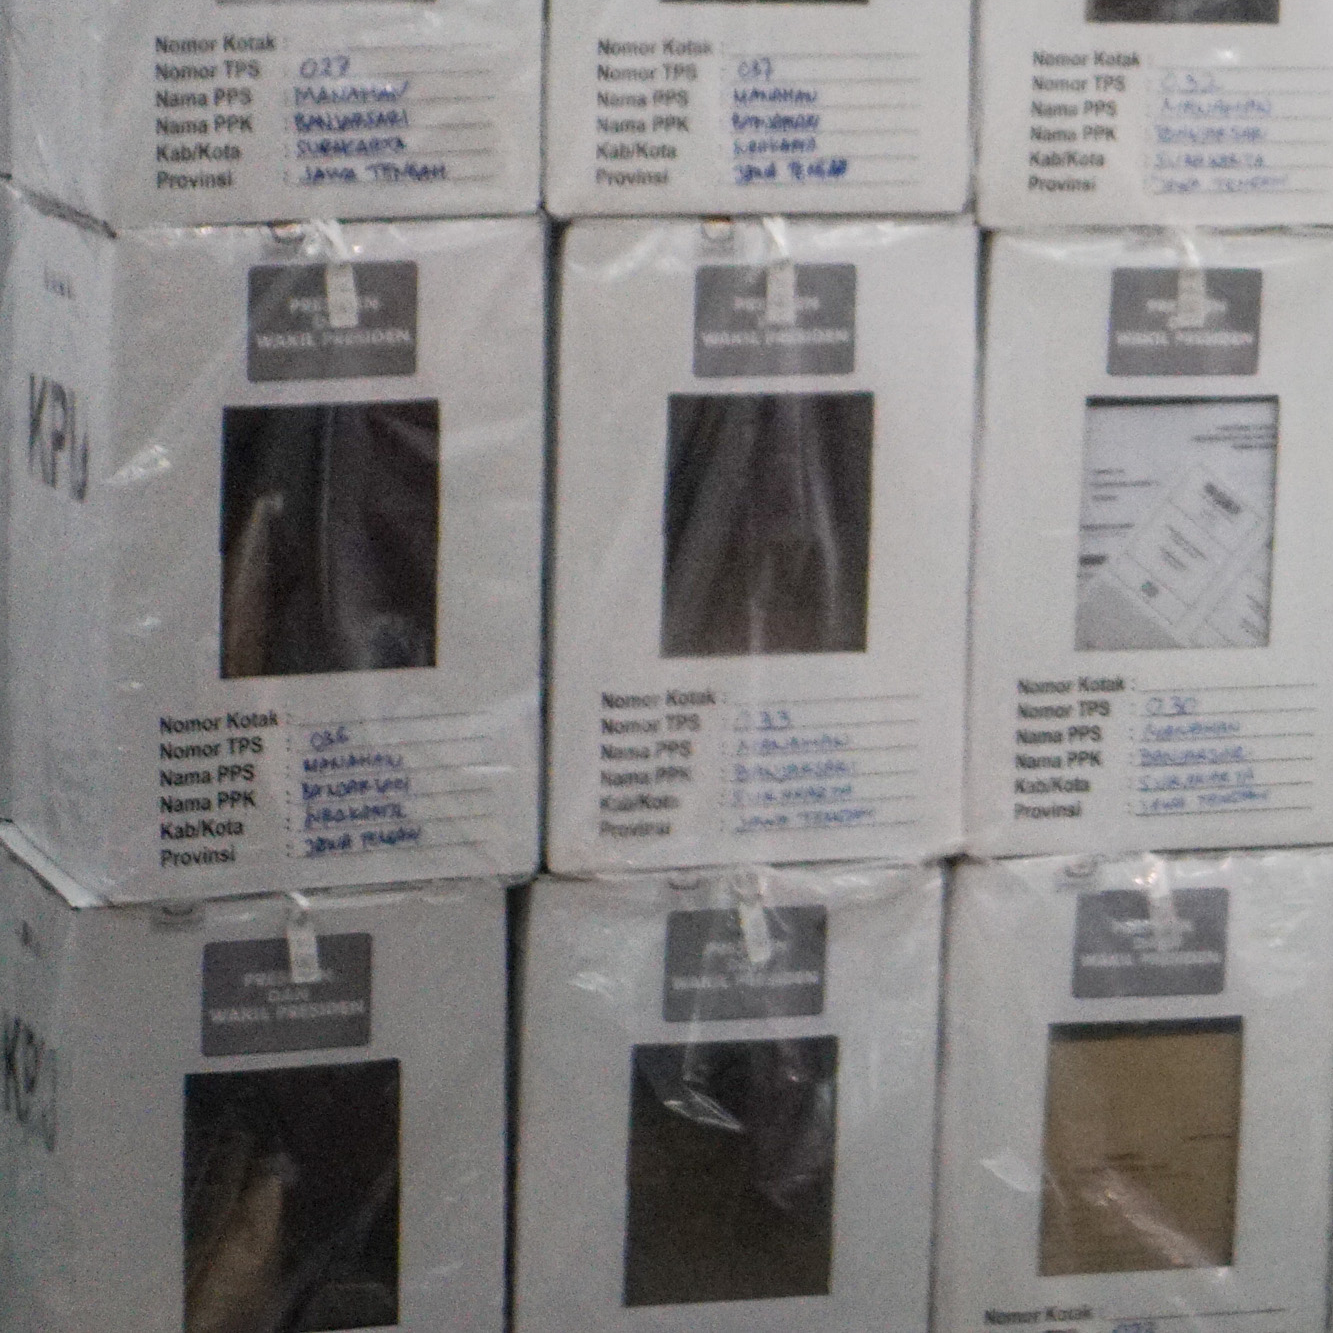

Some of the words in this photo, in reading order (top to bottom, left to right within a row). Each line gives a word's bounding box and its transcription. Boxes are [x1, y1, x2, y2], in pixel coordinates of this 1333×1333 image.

[155, 35, 217, 54] Nomor
[222, 34, 276, 53] Kotak
[154, 63, 217, 81] Nomor
[224, 59, 262, 79] TPS
[155, 90, 209, 108] Nama
[213, 87, 253, 106] PPS
[155, 118, 209, 135] Nama
[213, 114, 253, 133] PPK
[156, 142, 242, 163] Kab/Kota
[156, 170, 233, 189] Provinsi
[1078, 700, 1111, 717] TPS
[159, 716, 221, 736] Nomor
[226, 709, 279, 730] Kotak
[1068, 725, 1103, 742] PPS
[159, 742, 221, 761] Nomor
[225, 736, 264, 756] TPS
[1066, 750, 1102, 766] PPK
[159, 768, 213, 788] Nama
[217, 763, 255, 782] PPS
[159, 795, 212, 814] Nama
[217, 790, 257, 809] PPK
[159, 819, 245, 840] Kab/Kota
[159, 844, 237, 868] Provinsi
